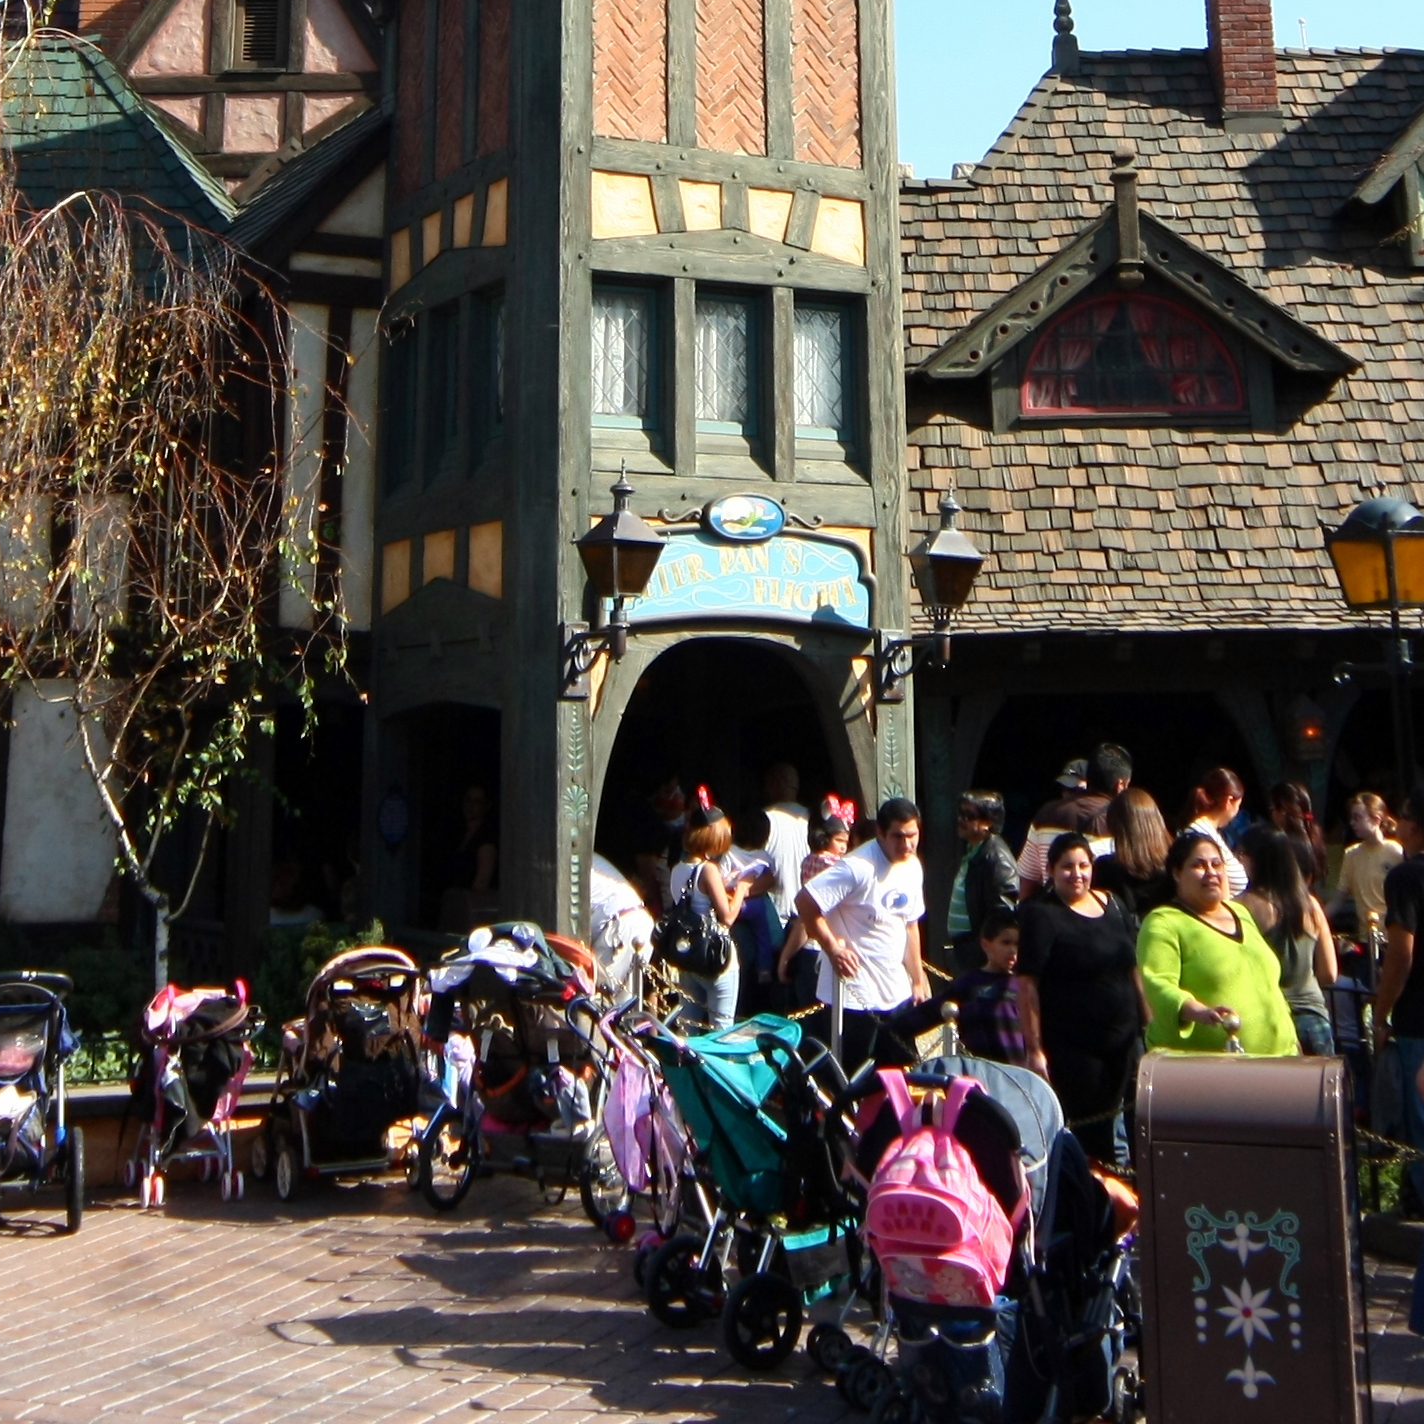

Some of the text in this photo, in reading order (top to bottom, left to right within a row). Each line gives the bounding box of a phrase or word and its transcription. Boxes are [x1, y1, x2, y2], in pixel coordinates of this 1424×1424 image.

[717, 542, 803, 576] PAN'S
[750, 573, 857, 611] FLIGHT
[883, 1200, 936, 1219] CARE
[881, 1217, 948, 1238] BEARS
